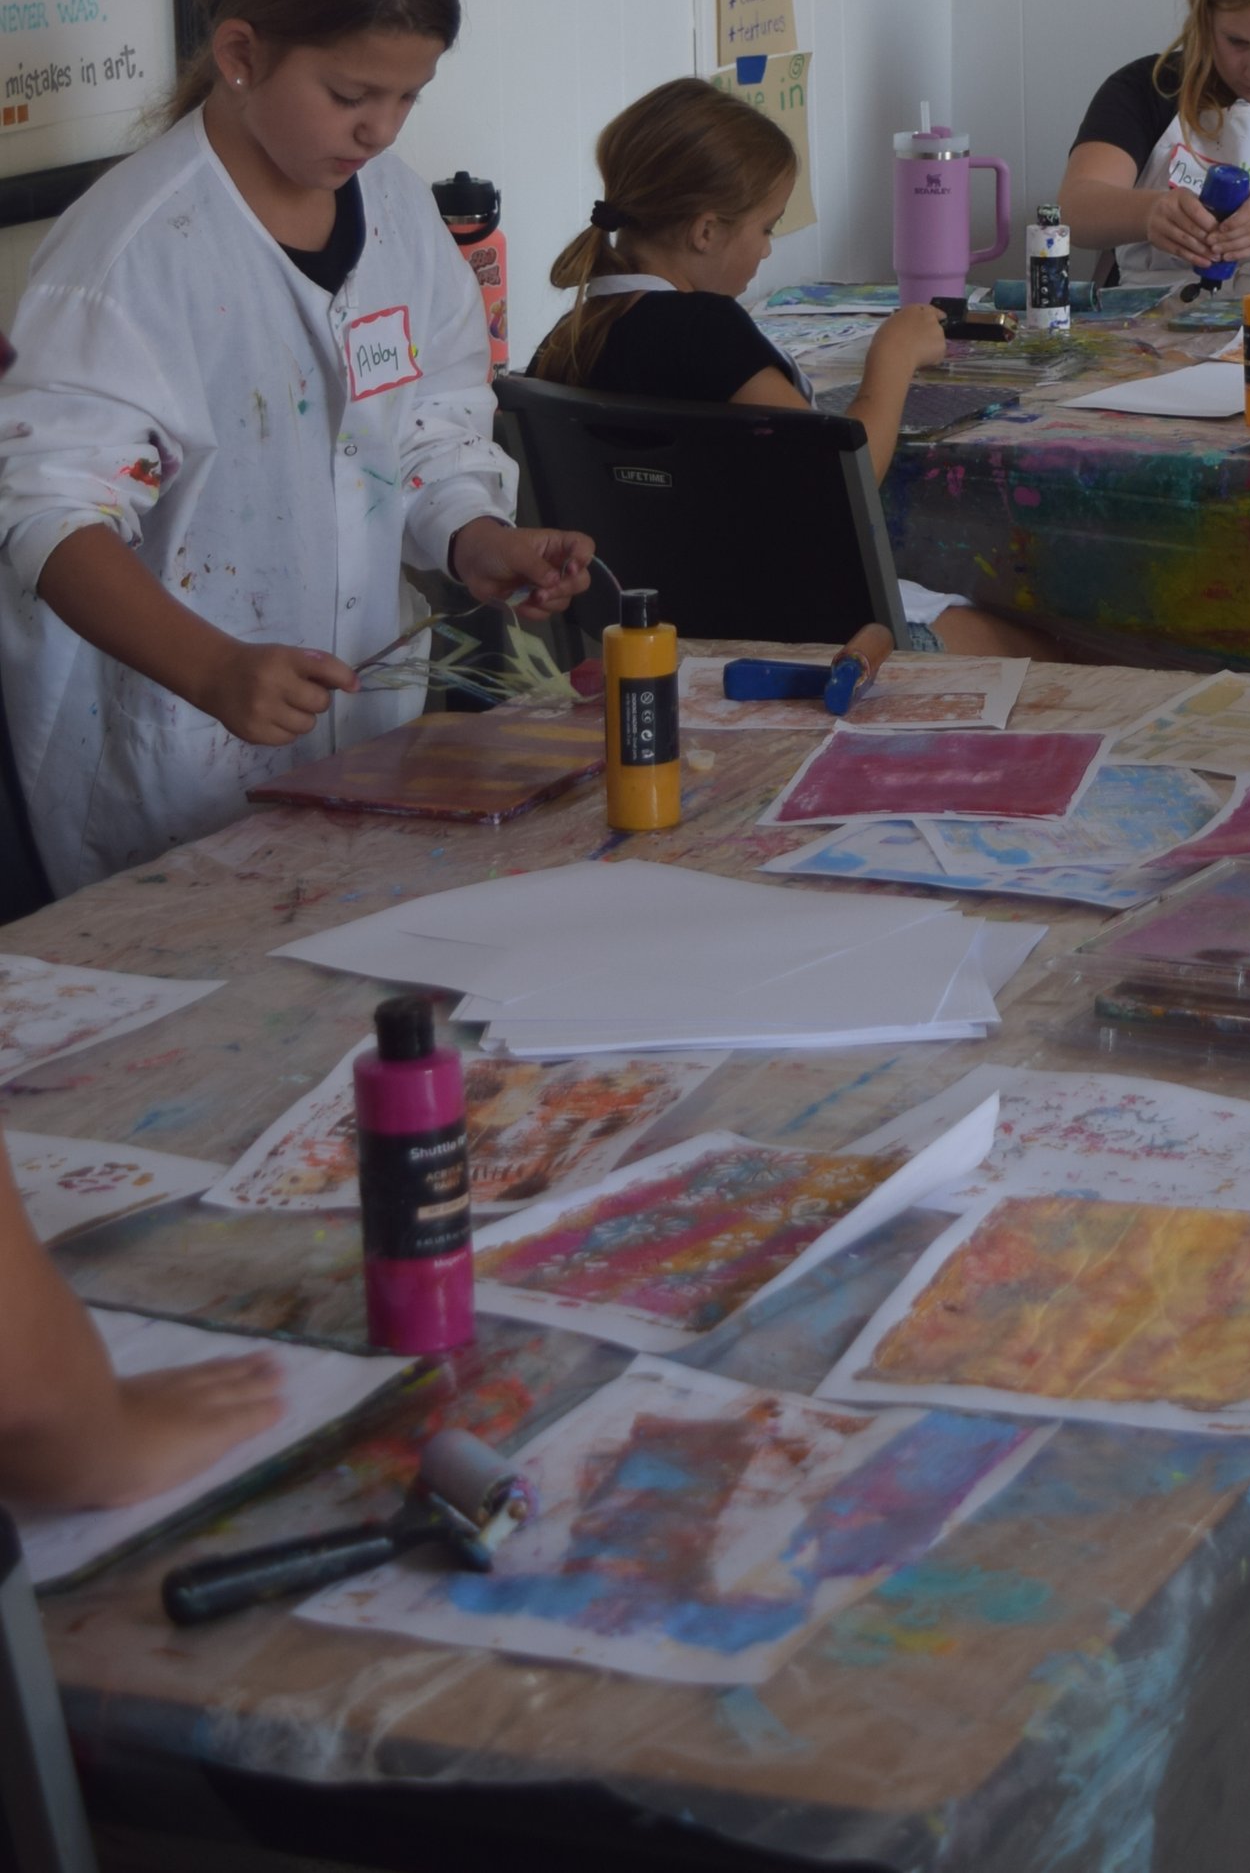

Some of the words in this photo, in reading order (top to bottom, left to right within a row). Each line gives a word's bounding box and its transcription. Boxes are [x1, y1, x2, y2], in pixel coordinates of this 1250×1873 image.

[5, 62, 72, 101] mistakes
[80, 57, 97, 87] in
[103, 44, 144, 81] art.
[780, 77, 805, 111] in
[914, 187, 951, 195] STANLEY
[356, 342, 399, 378] Abby
[620, 469, 667, 485] LIFETIME
[410, 1140, 457, 1161] Shuttle
